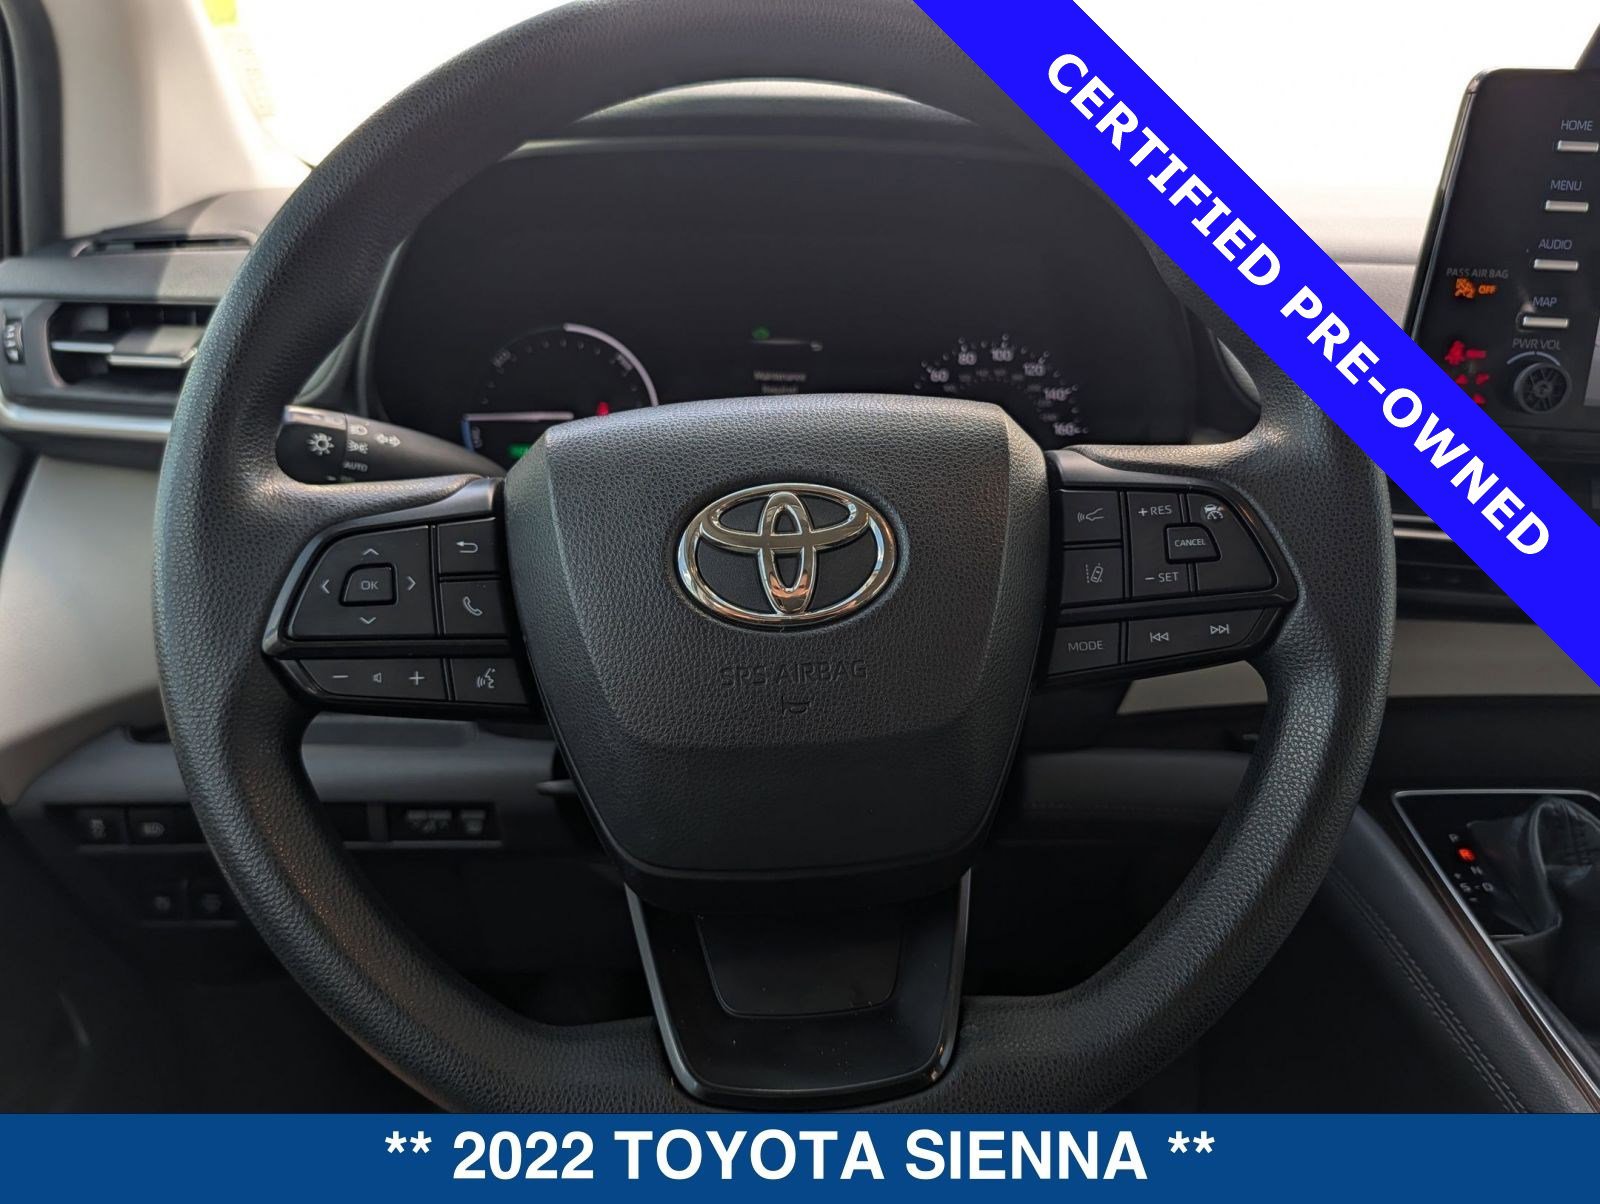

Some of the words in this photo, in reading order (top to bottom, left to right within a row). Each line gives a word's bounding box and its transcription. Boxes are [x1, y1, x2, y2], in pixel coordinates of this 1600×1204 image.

[1560, 119, 1594, 131] HOME
[1550, 180, 1583, 191] MENU
[1537, 238, 1573, 251] AUDIO
[1445, 267, 1471, 277] PASS
[1478, 284, 1497, 295] OFF
[1532, 296, 1558, 308] MAP
[1512, 338, 1541, 350] PWR
[1540, 339, 1561, 351] VOL
[958, 352, 977, 365] 80
[991, 348, 1013, 361] 100
[931, 369, 950, 382] 60
[1024, 363, 1045, 377] 120
[343, 461, 369, 473] AUTO
[1174, 538, 1206, 548] CANCEL
[360, 580, 379, 592] OK
[1067, 639, 1104, 652] MODE
[775, 659, 867, 685] AIRBAG
